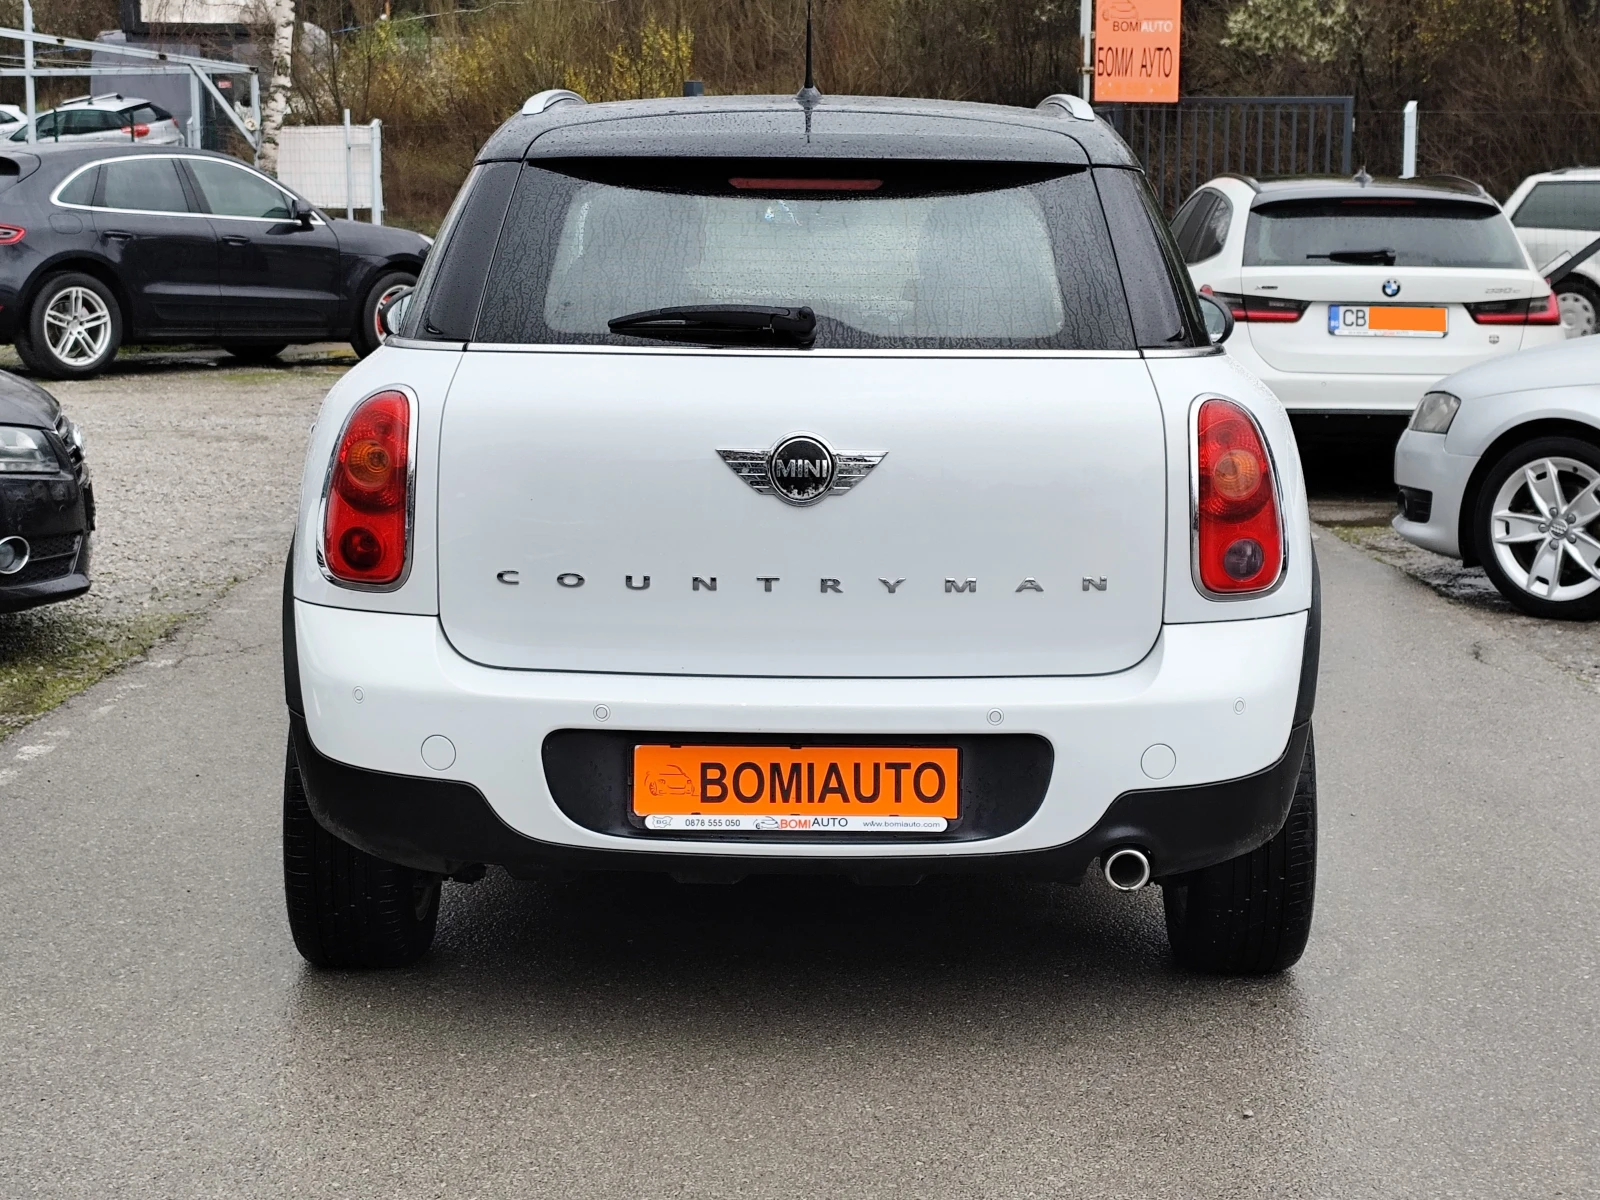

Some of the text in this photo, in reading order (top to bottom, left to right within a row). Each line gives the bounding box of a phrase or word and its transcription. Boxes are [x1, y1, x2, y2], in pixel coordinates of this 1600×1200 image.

[1097, 46, 1173, 78] БОМИ АУТО
[776, 459, 828, 478] MINI
[496, 569, 1109, 593] COUNTRYMAN
[700, 762, 946, 804] BOMIAUTO
[685, 818, 741, 827] 0878 555 050
[862, 820, 941, 829] www.bomiauto.com
